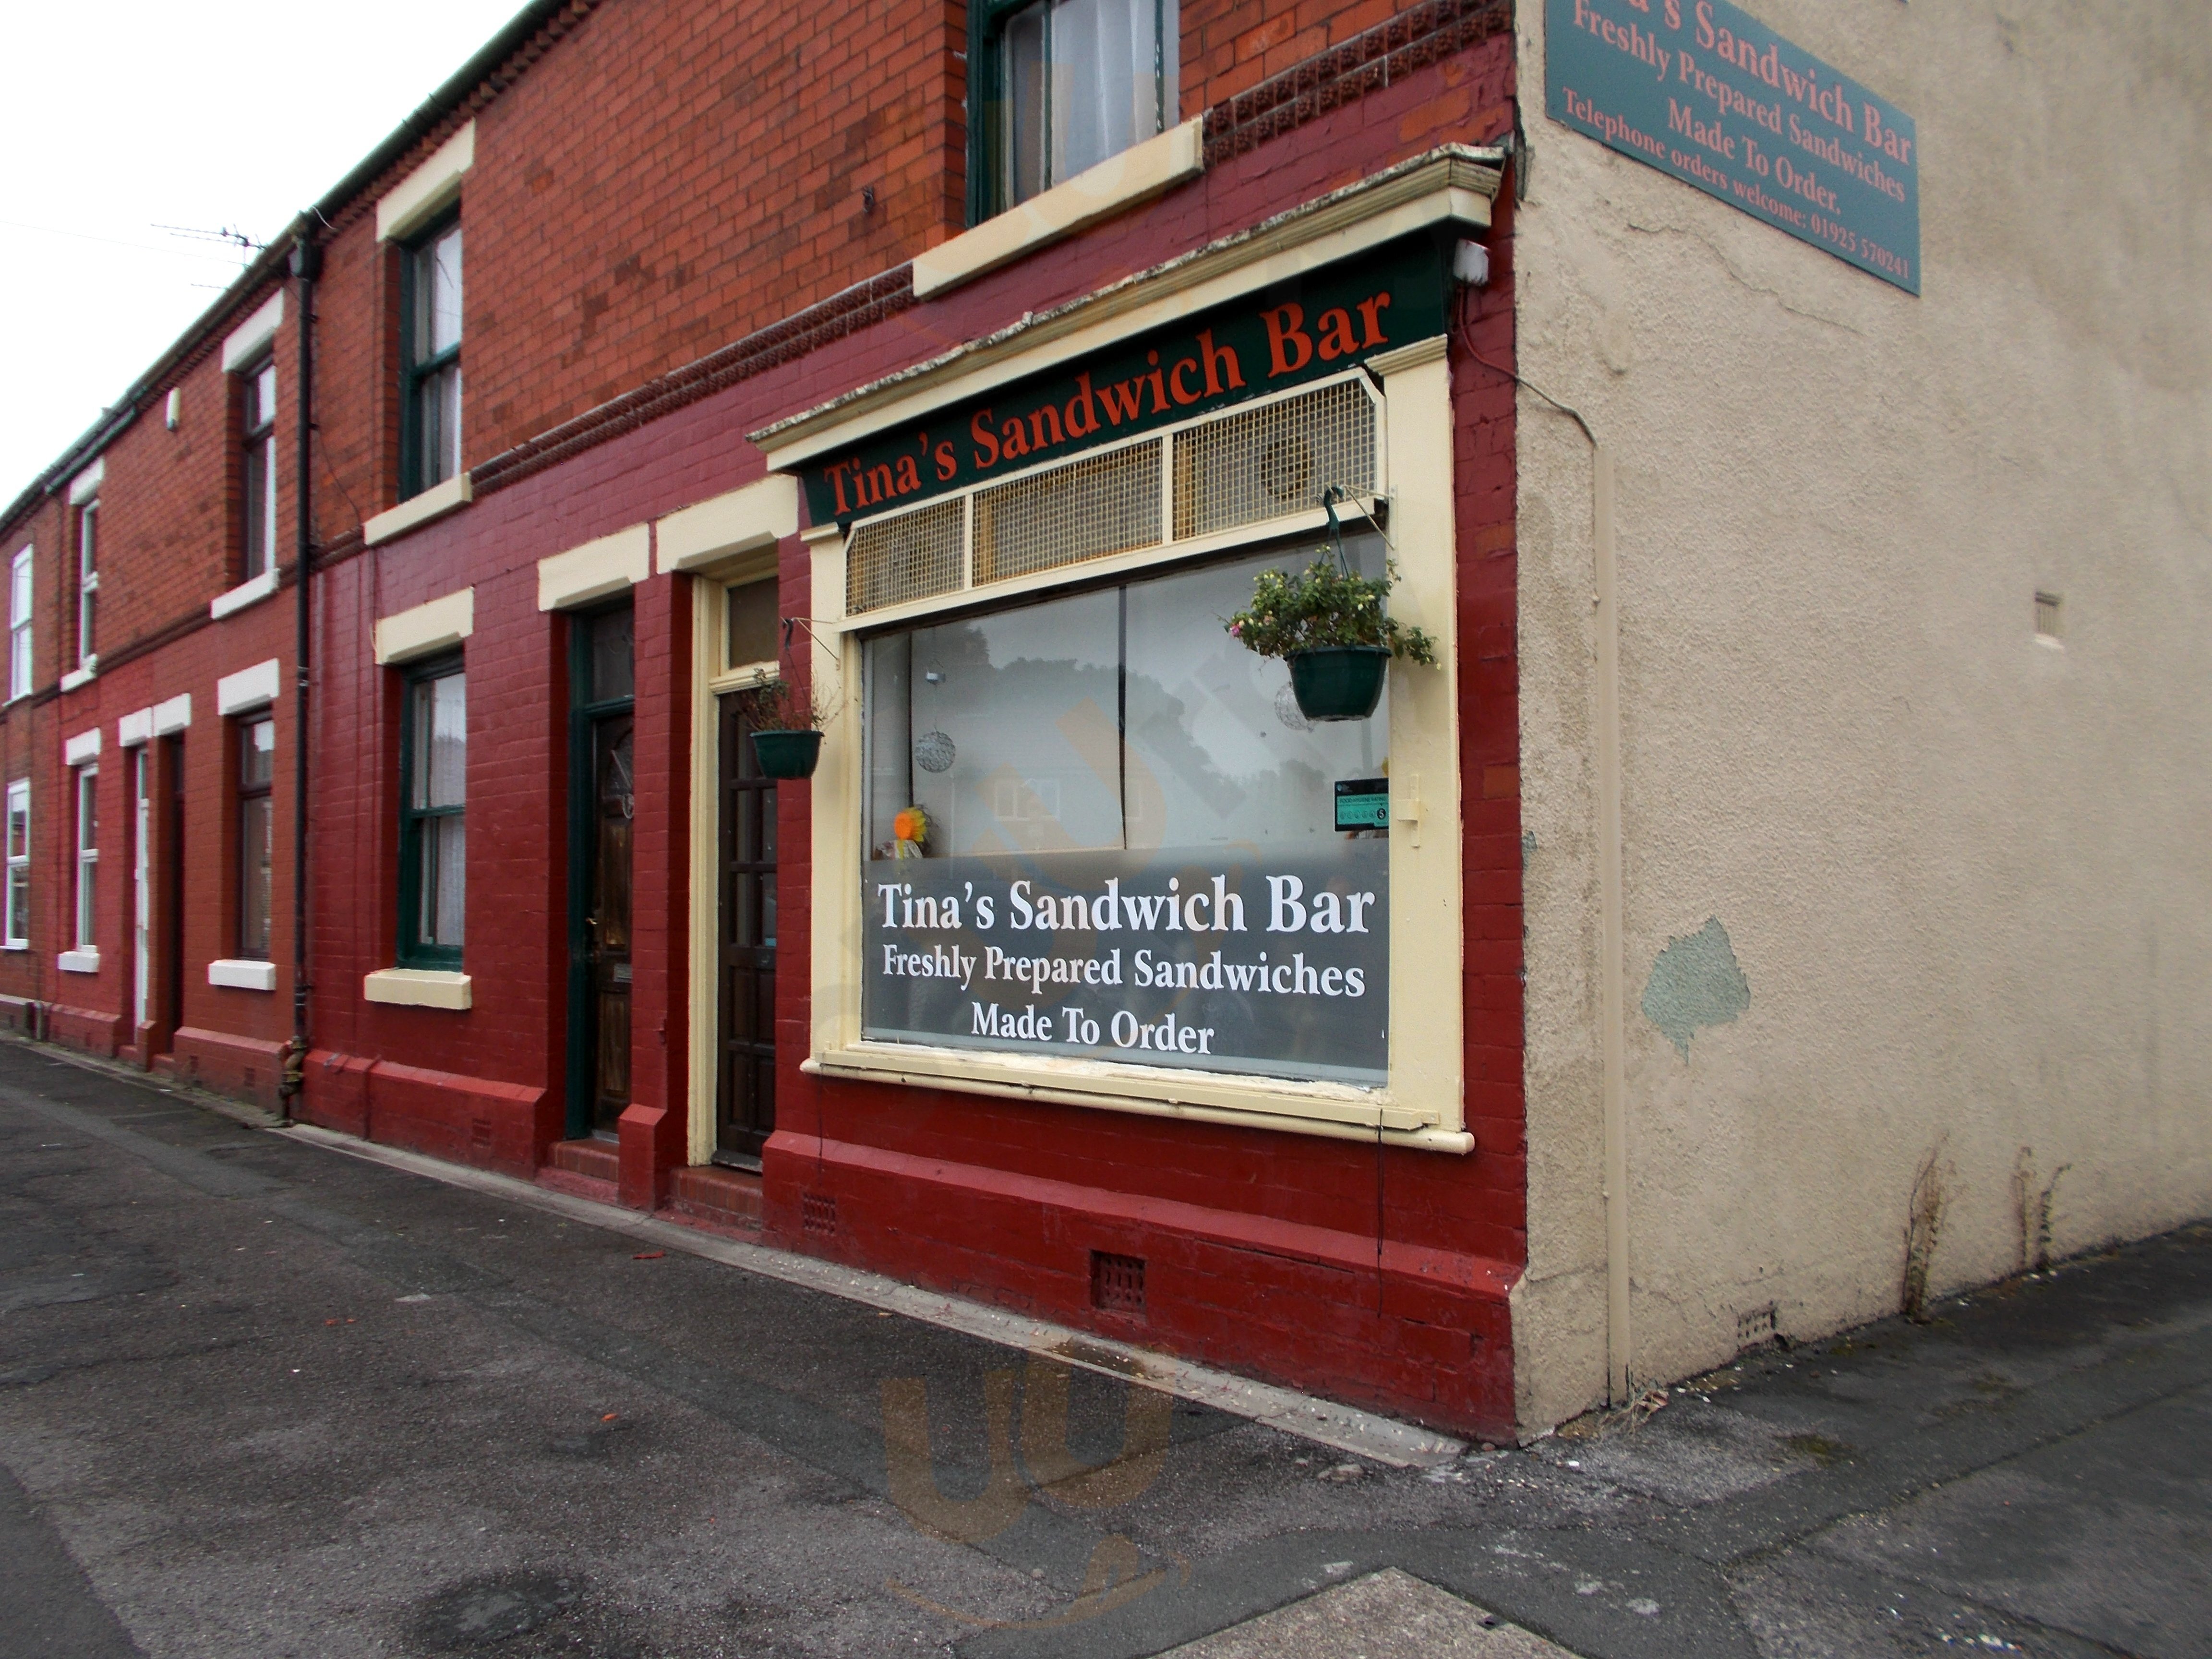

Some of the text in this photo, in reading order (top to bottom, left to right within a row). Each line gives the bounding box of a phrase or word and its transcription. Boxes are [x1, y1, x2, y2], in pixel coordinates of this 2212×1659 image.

[1574, 0, 1905, 203] Freshly Prepared Sandwiches
[1695, 0, 1912, 165] Sandwich Bar
[1562, 86, 1909, 279] Telephone orders welcome: 01925 570241
[1668, 97, 1841, 215] Made To Order.
[823, 291, 1391, 517] Tina's Sandwich Bar
[878, 874, 1376, 934] Tina's Sandwich Bar
[882, 944, 1366, 998] Freshly Prepared Sandwiches
[971, 1001, 1215, 1054] Made To Order
